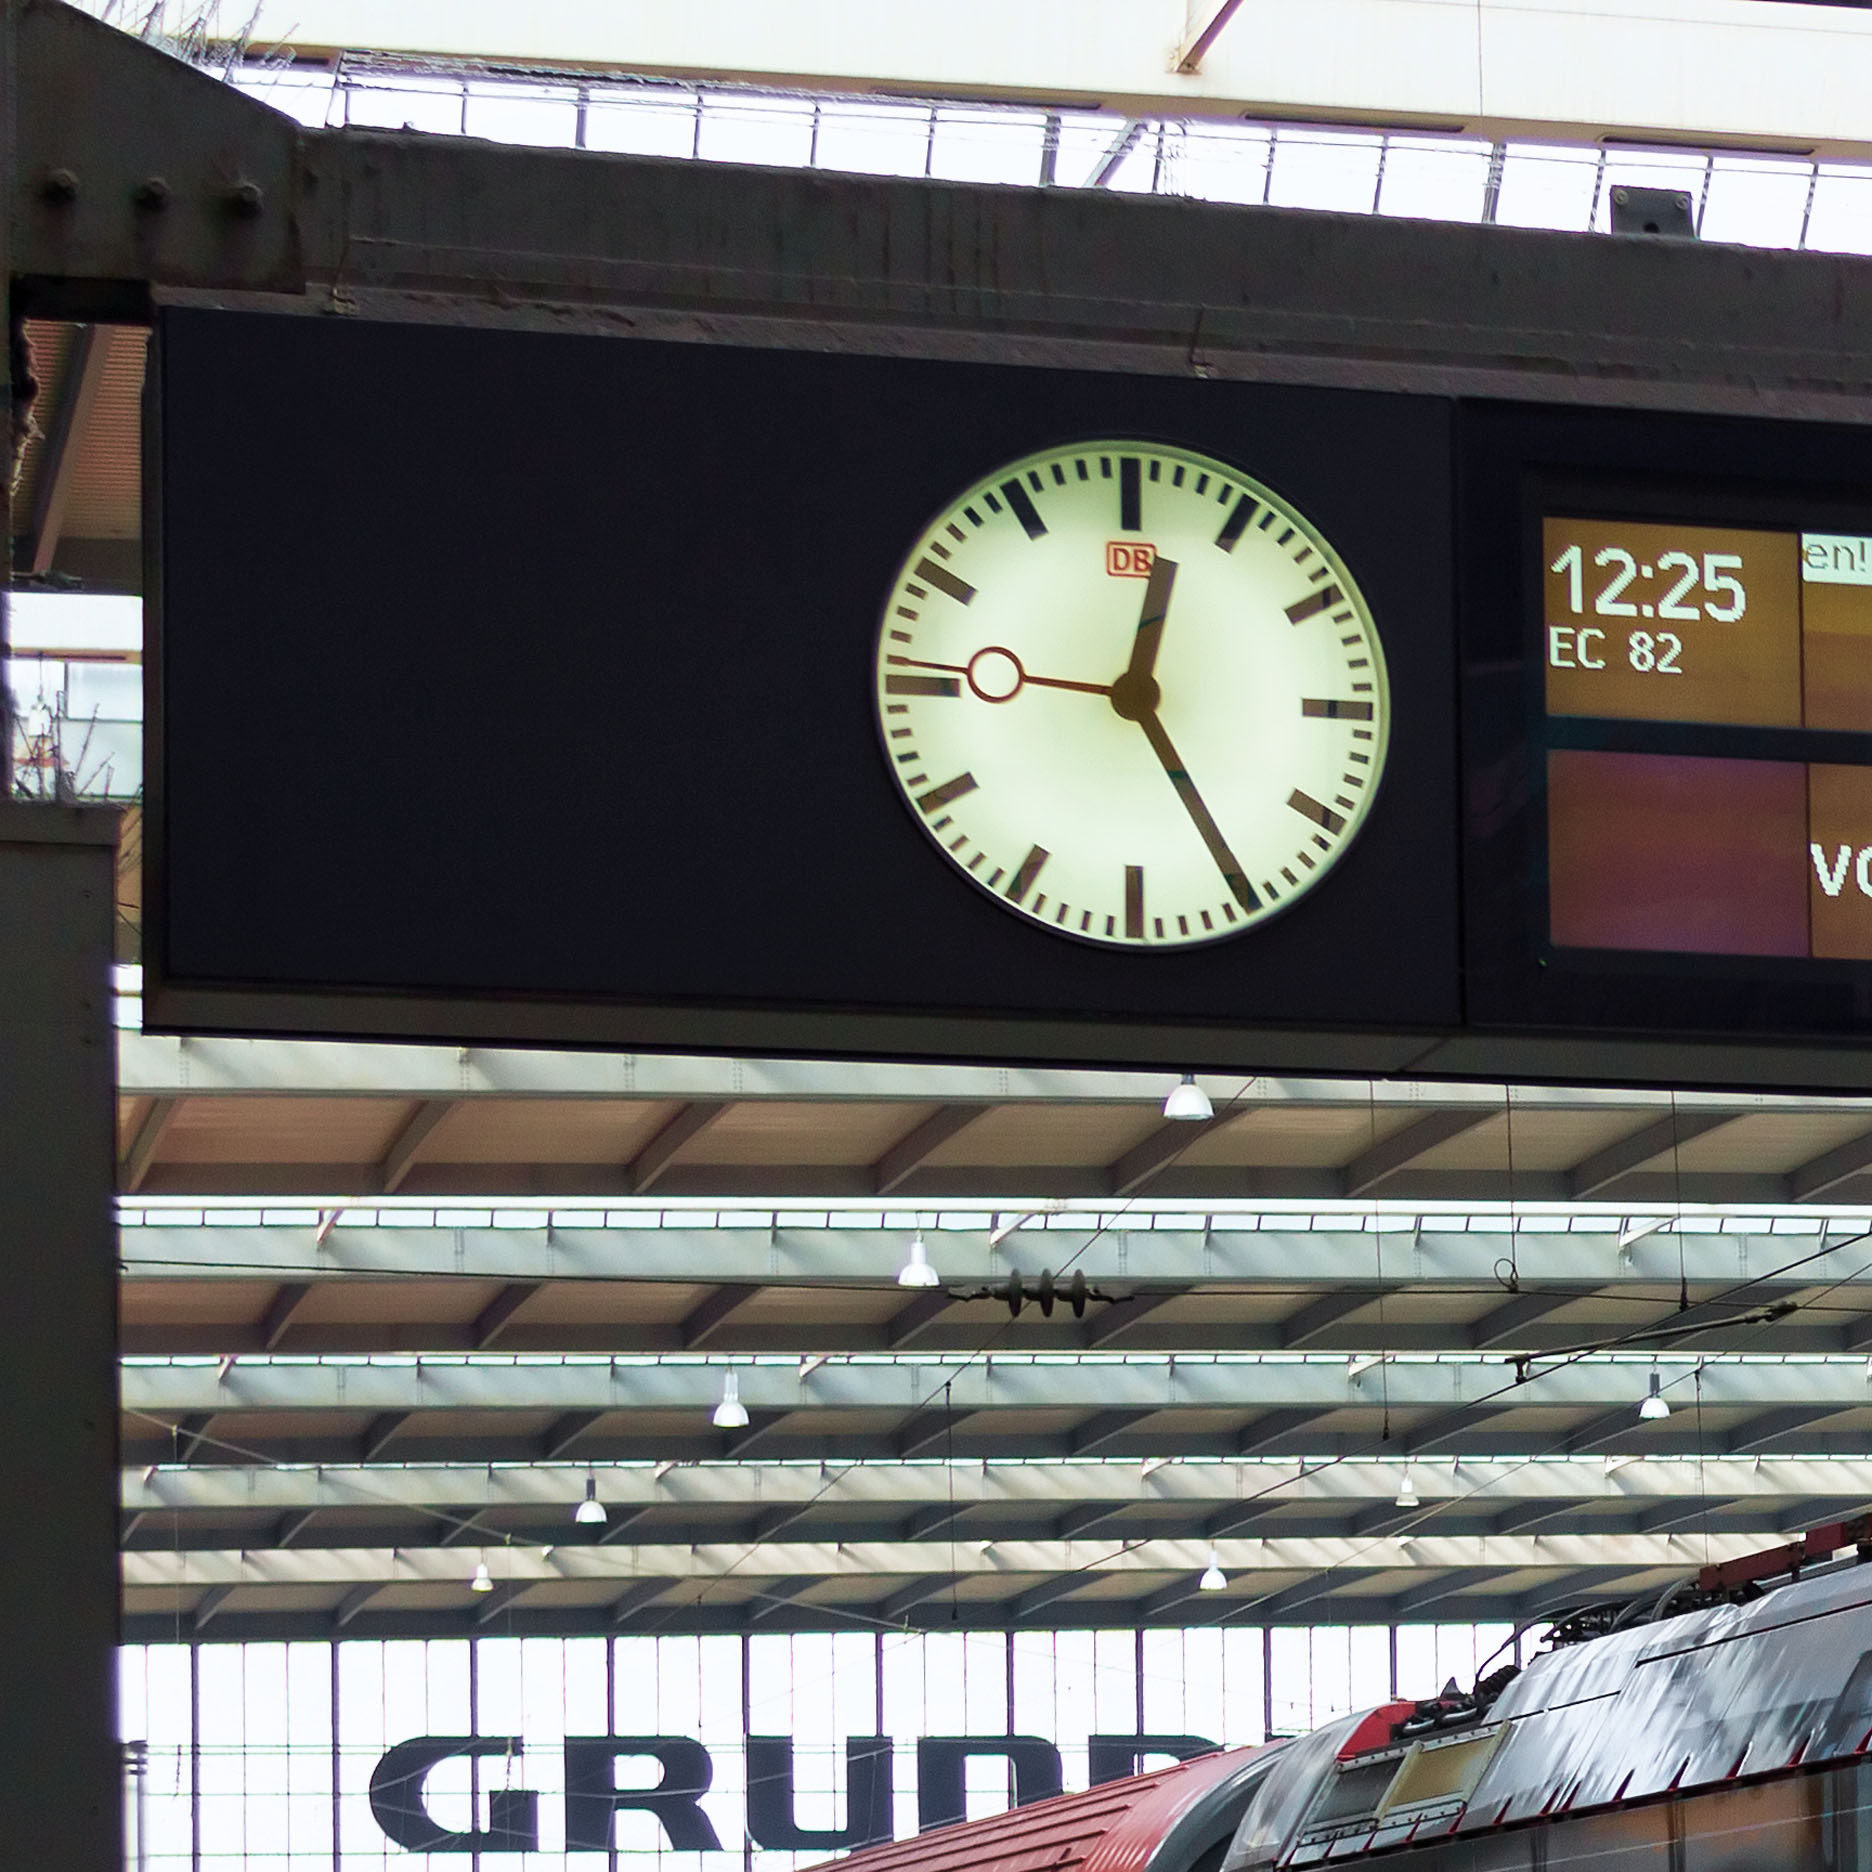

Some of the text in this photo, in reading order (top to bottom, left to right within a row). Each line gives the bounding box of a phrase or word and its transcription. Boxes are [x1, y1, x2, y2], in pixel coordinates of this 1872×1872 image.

[1111, 546, 1153, 574] DB
[1803, 541, 1866, 572] en!
[1551, 545, 1746, 622] 12:25
[1550, 626, 1683, 673] EC 82
